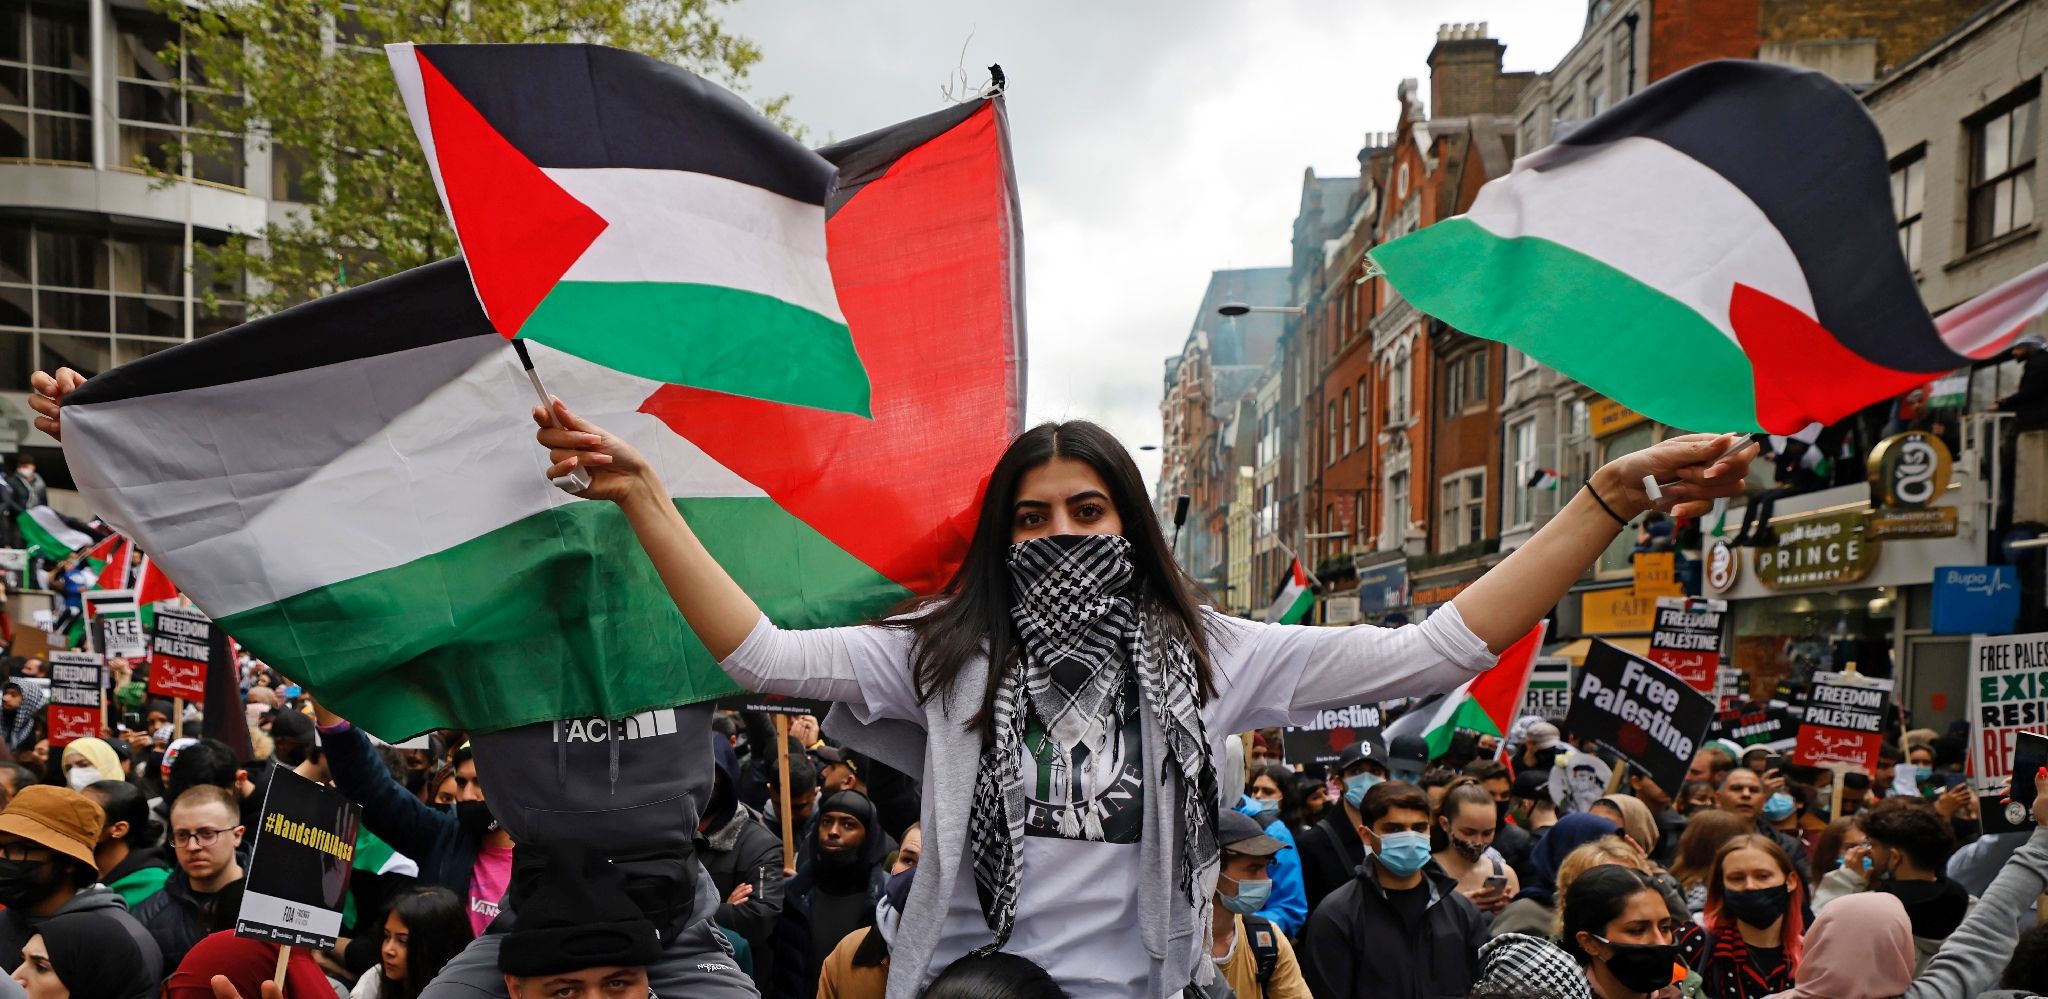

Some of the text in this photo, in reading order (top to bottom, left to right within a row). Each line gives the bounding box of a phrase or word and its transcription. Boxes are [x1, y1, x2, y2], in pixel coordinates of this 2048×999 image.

[1760, 540, 1859, 572] PRINCE
[1947, 570, 1986, 585] Bupa
[158, 615, 209, 639] FREEDOM
[1661, 610, 1720, 628] FREEDOM
[154, 637, 211, 662] PALESTINE
[1653, 631, 1720, 650] PALESTINE
[1980, 645, 2010, 672] FREE
[53, 664, 98, 683] FREEDOM
[51, 687, 100, 706] PALESTINE
[1620, 660, 1680, 713] Free
[1813, 685, 1882, 708] FREEDOM
[1579, 672, 1693, 761] Palestine
[1805, 707, 1882, 731] PALESTINE
[1361, 741, 1371, 756] G
[264, 812, 353, 862] #HandsOffAlAqsa
[471, 896, 501, 917] VANS
